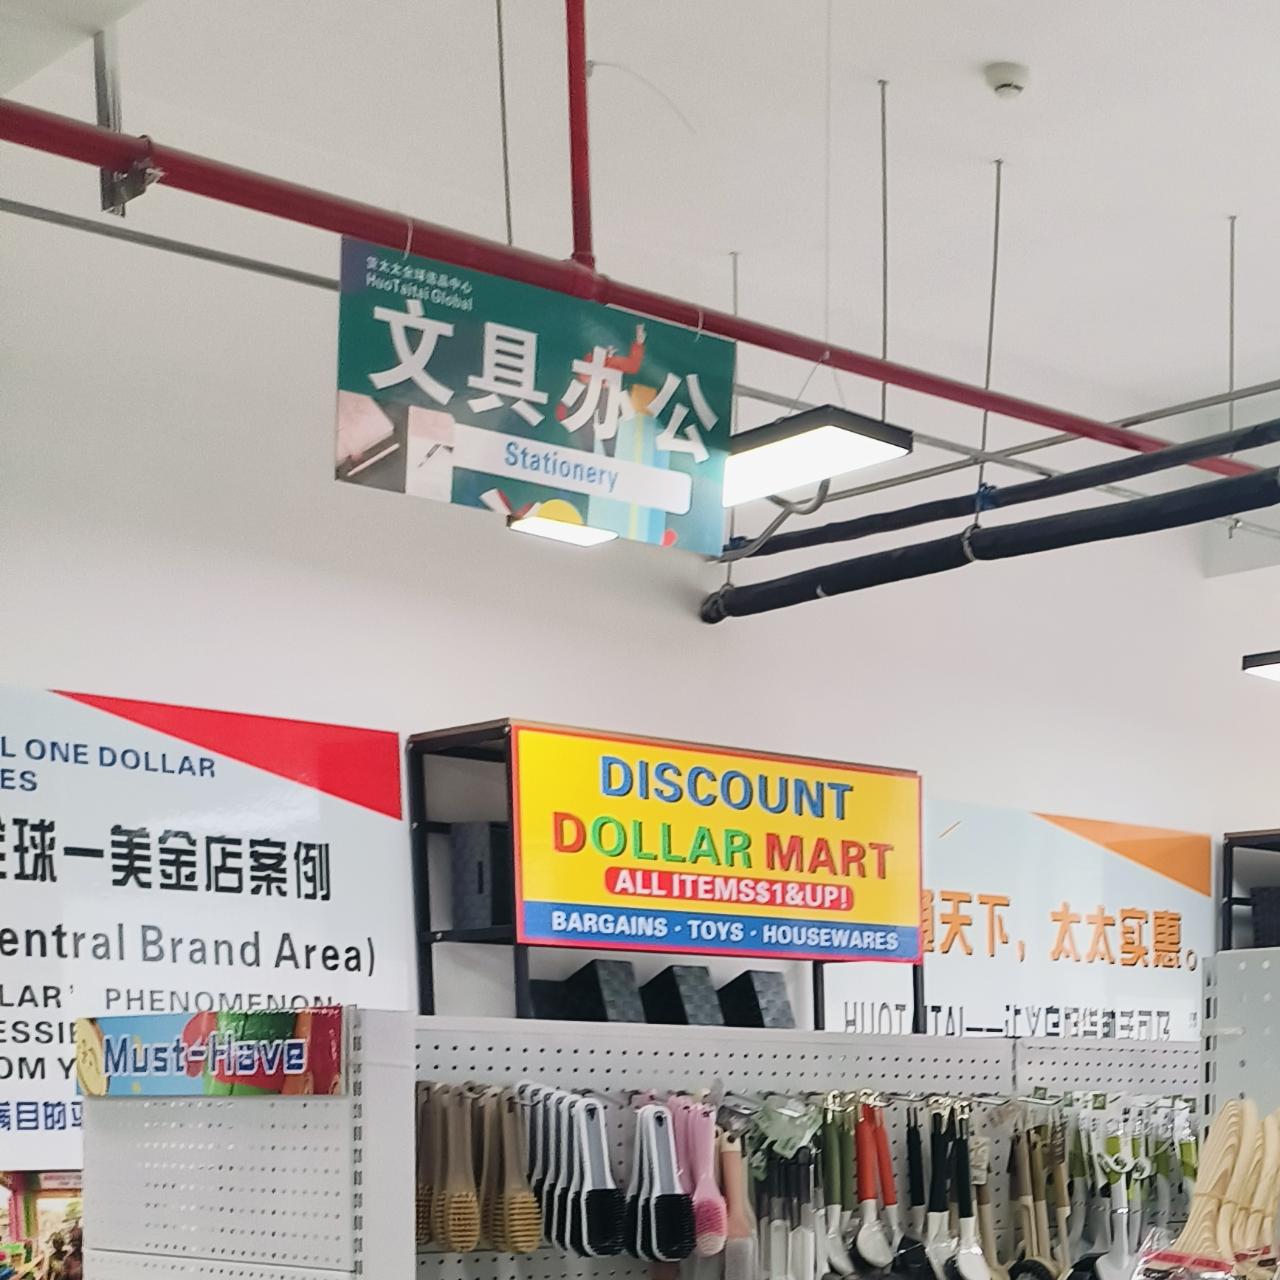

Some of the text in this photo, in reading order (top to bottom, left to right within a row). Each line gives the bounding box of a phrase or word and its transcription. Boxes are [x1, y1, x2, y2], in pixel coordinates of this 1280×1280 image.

[367, 298, 720, 463] 文具办公
[504, 440, 618, 492] Stationery
[24, 738, 89, 766] ONE
[98, 746, 216, 778] DOLLAR
[599, 755, 854, 821] DISCOUNT
[0, 815, 332, 902] 球一美金店案例
[552, 811, 894, 880] DOLLAR MART
[613, 868, 666, 898] ALL
[140, 923, 261, 970] Brand
[273, 930, 376, 977] Area)
[550, 909, 899, 952] BARGAINS TOYS HOUSEWARES
[102, 1032, 307, 1077] Must-Have
